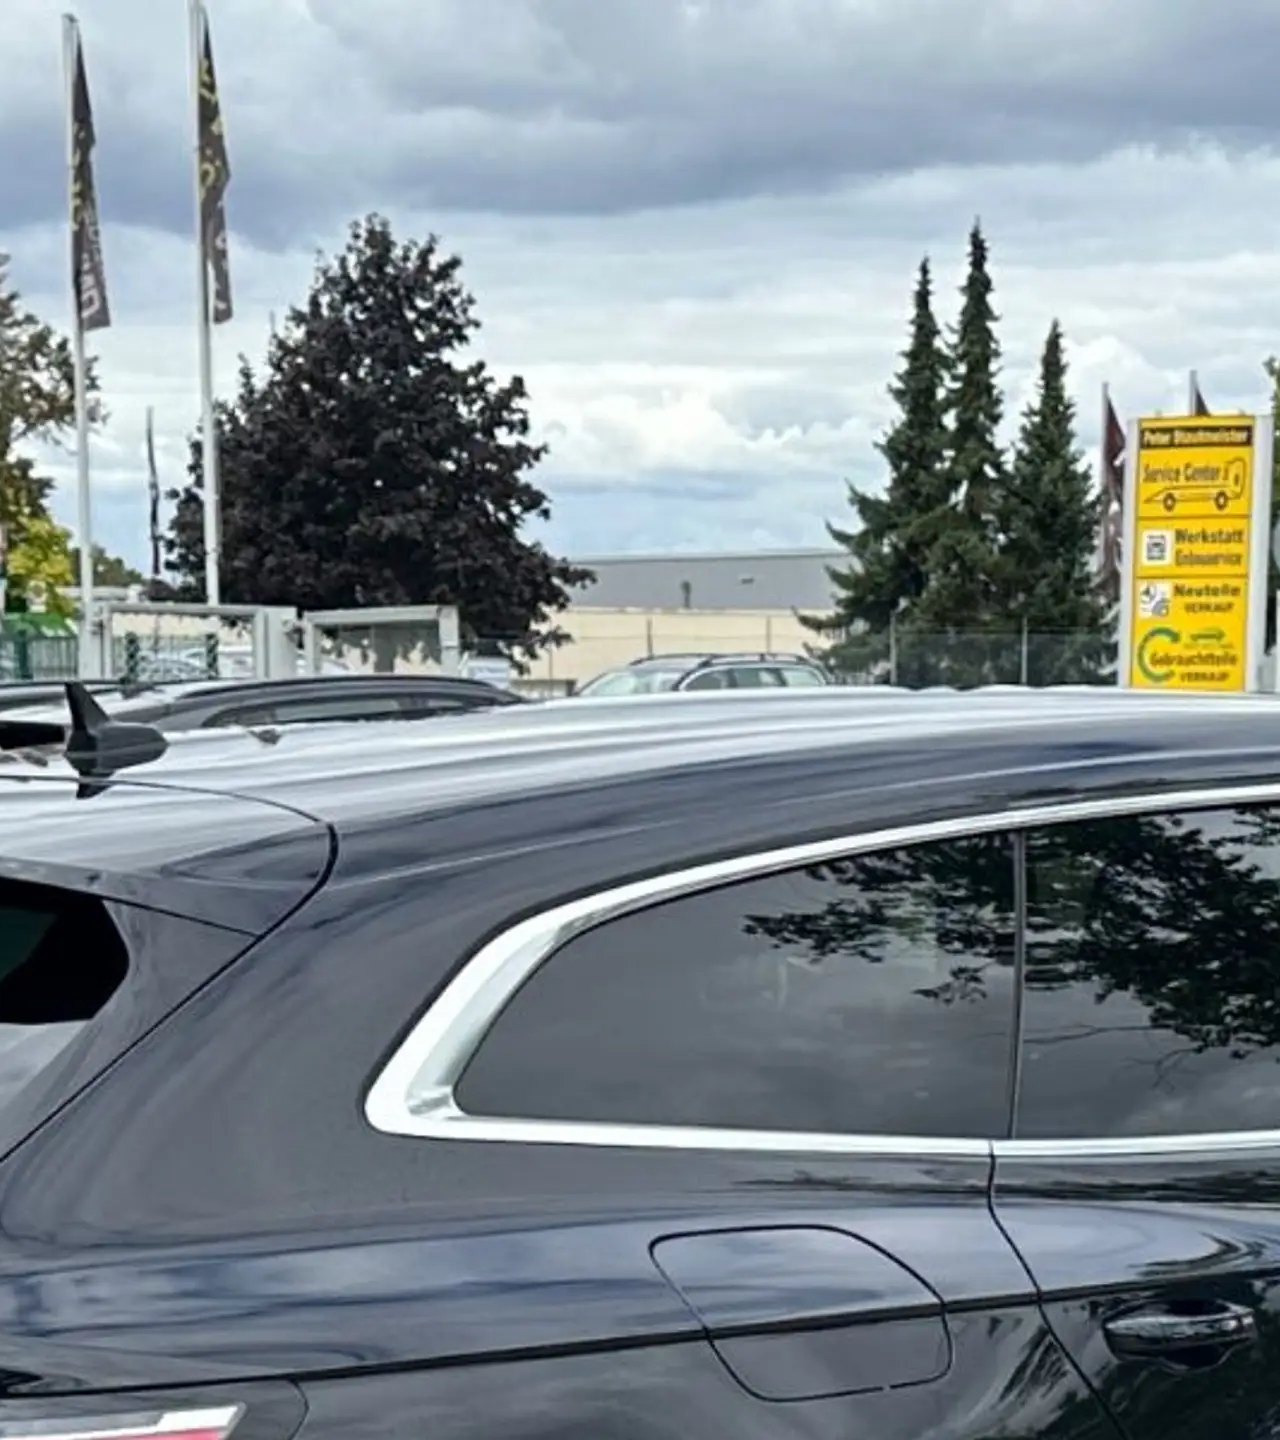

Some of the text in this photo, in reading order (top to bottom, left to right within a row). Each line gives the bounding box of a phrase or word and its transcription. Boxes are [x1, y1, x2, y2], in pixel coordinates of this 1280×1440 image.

[1142, 461, 1221, 484] Service Center
[1175, 527, 1244, 545] Werkstatt
[1183, 601, 1235, 614] VERKAUF
[1180, 671, 1231, 683] VERKAUF
